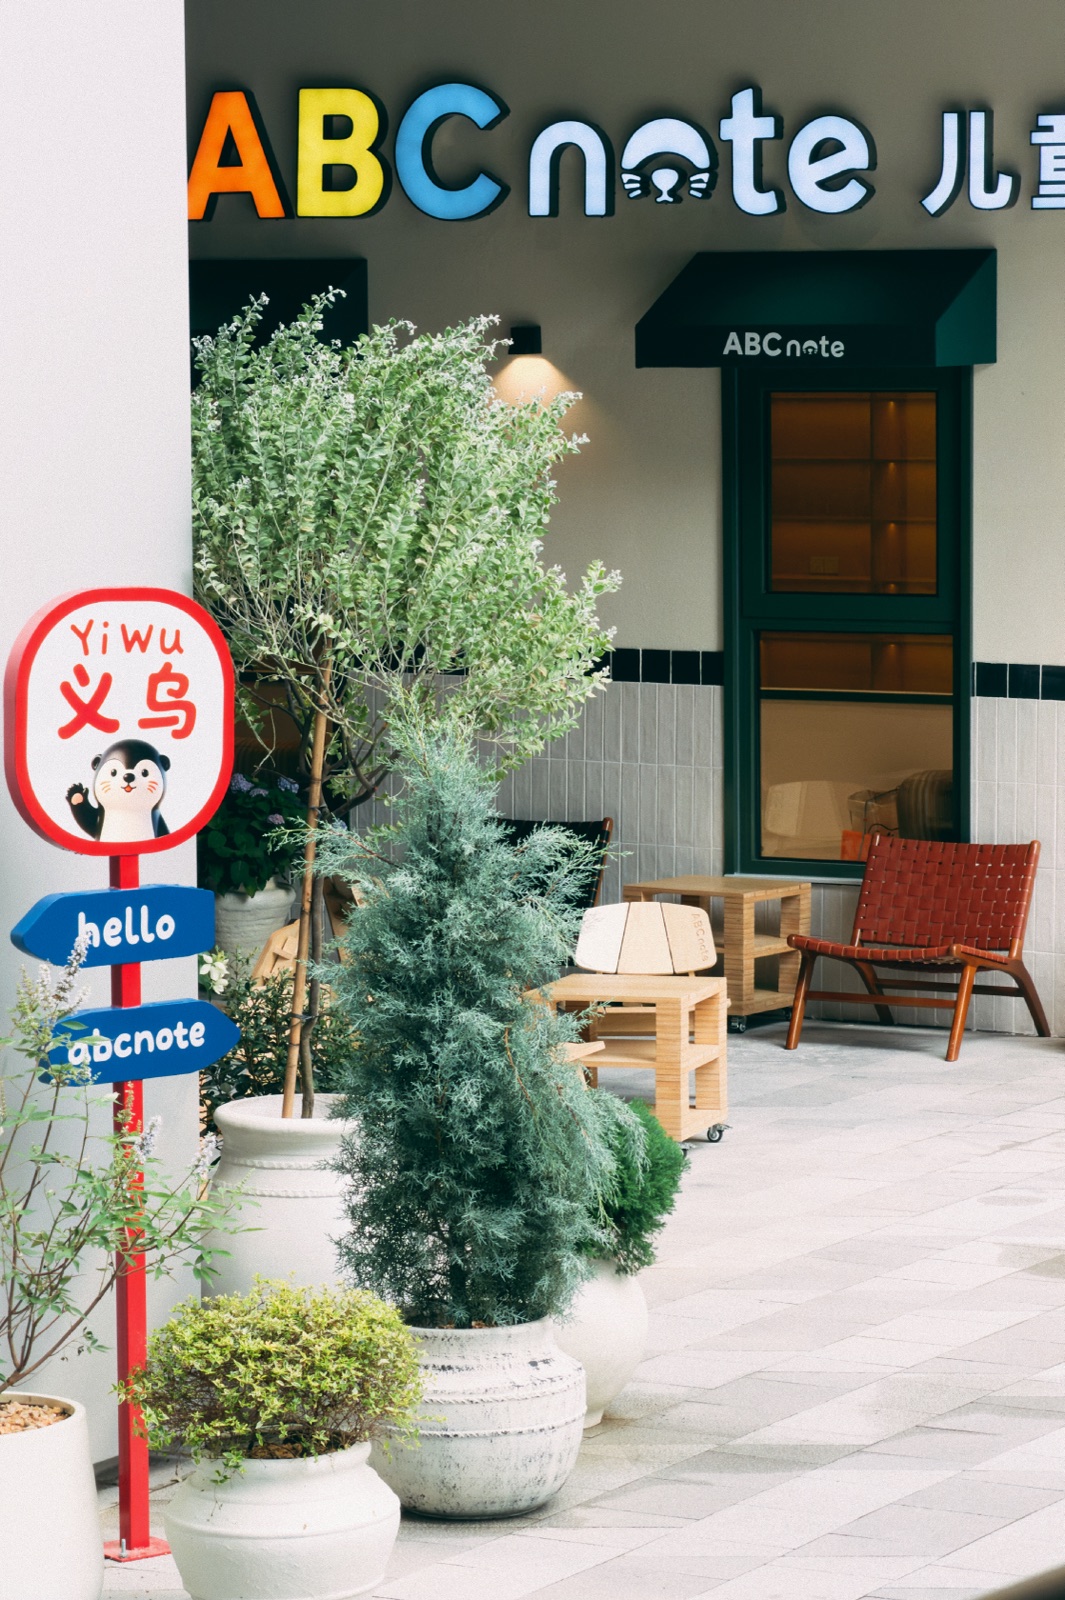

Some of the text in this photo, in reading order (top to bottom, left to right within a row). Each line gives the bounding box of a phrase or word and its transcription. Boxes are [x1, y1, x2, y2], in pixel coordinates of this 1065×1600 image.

[57, 661, 197, 740] 义乌
[77, 904, 176, 949] hello
[67, 1021, 206, 1066] abcnote
